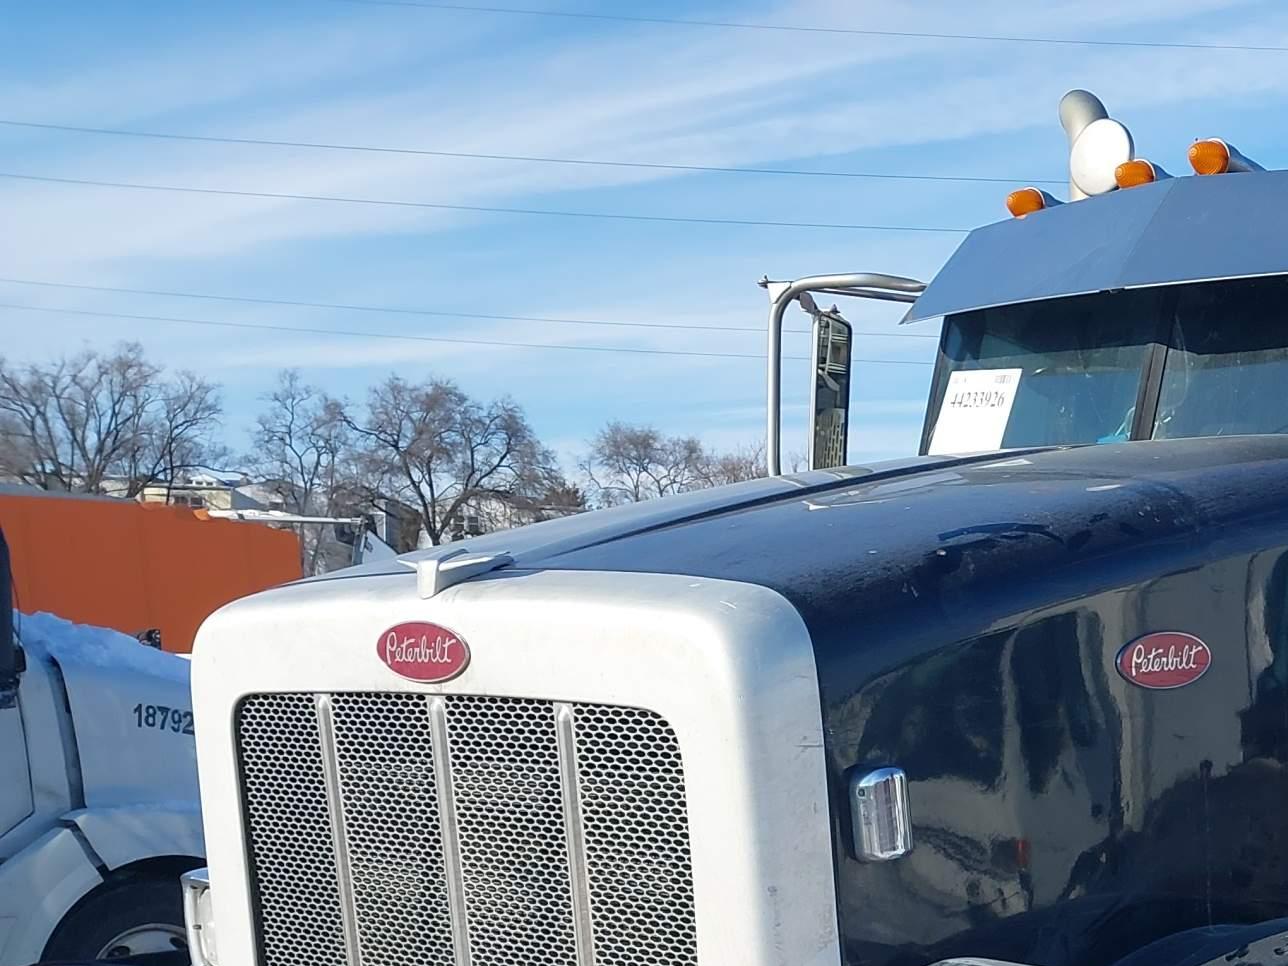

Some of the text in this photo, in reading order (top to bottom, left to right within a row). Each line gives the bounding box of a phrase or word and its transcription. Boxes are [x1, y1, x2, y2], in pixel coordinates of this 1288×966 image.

[950, 391, 1006, 408] 44233926
[385, 632, 456, 665] Peterbilt
[1131, 644, 1203, 677] Peterbilt
